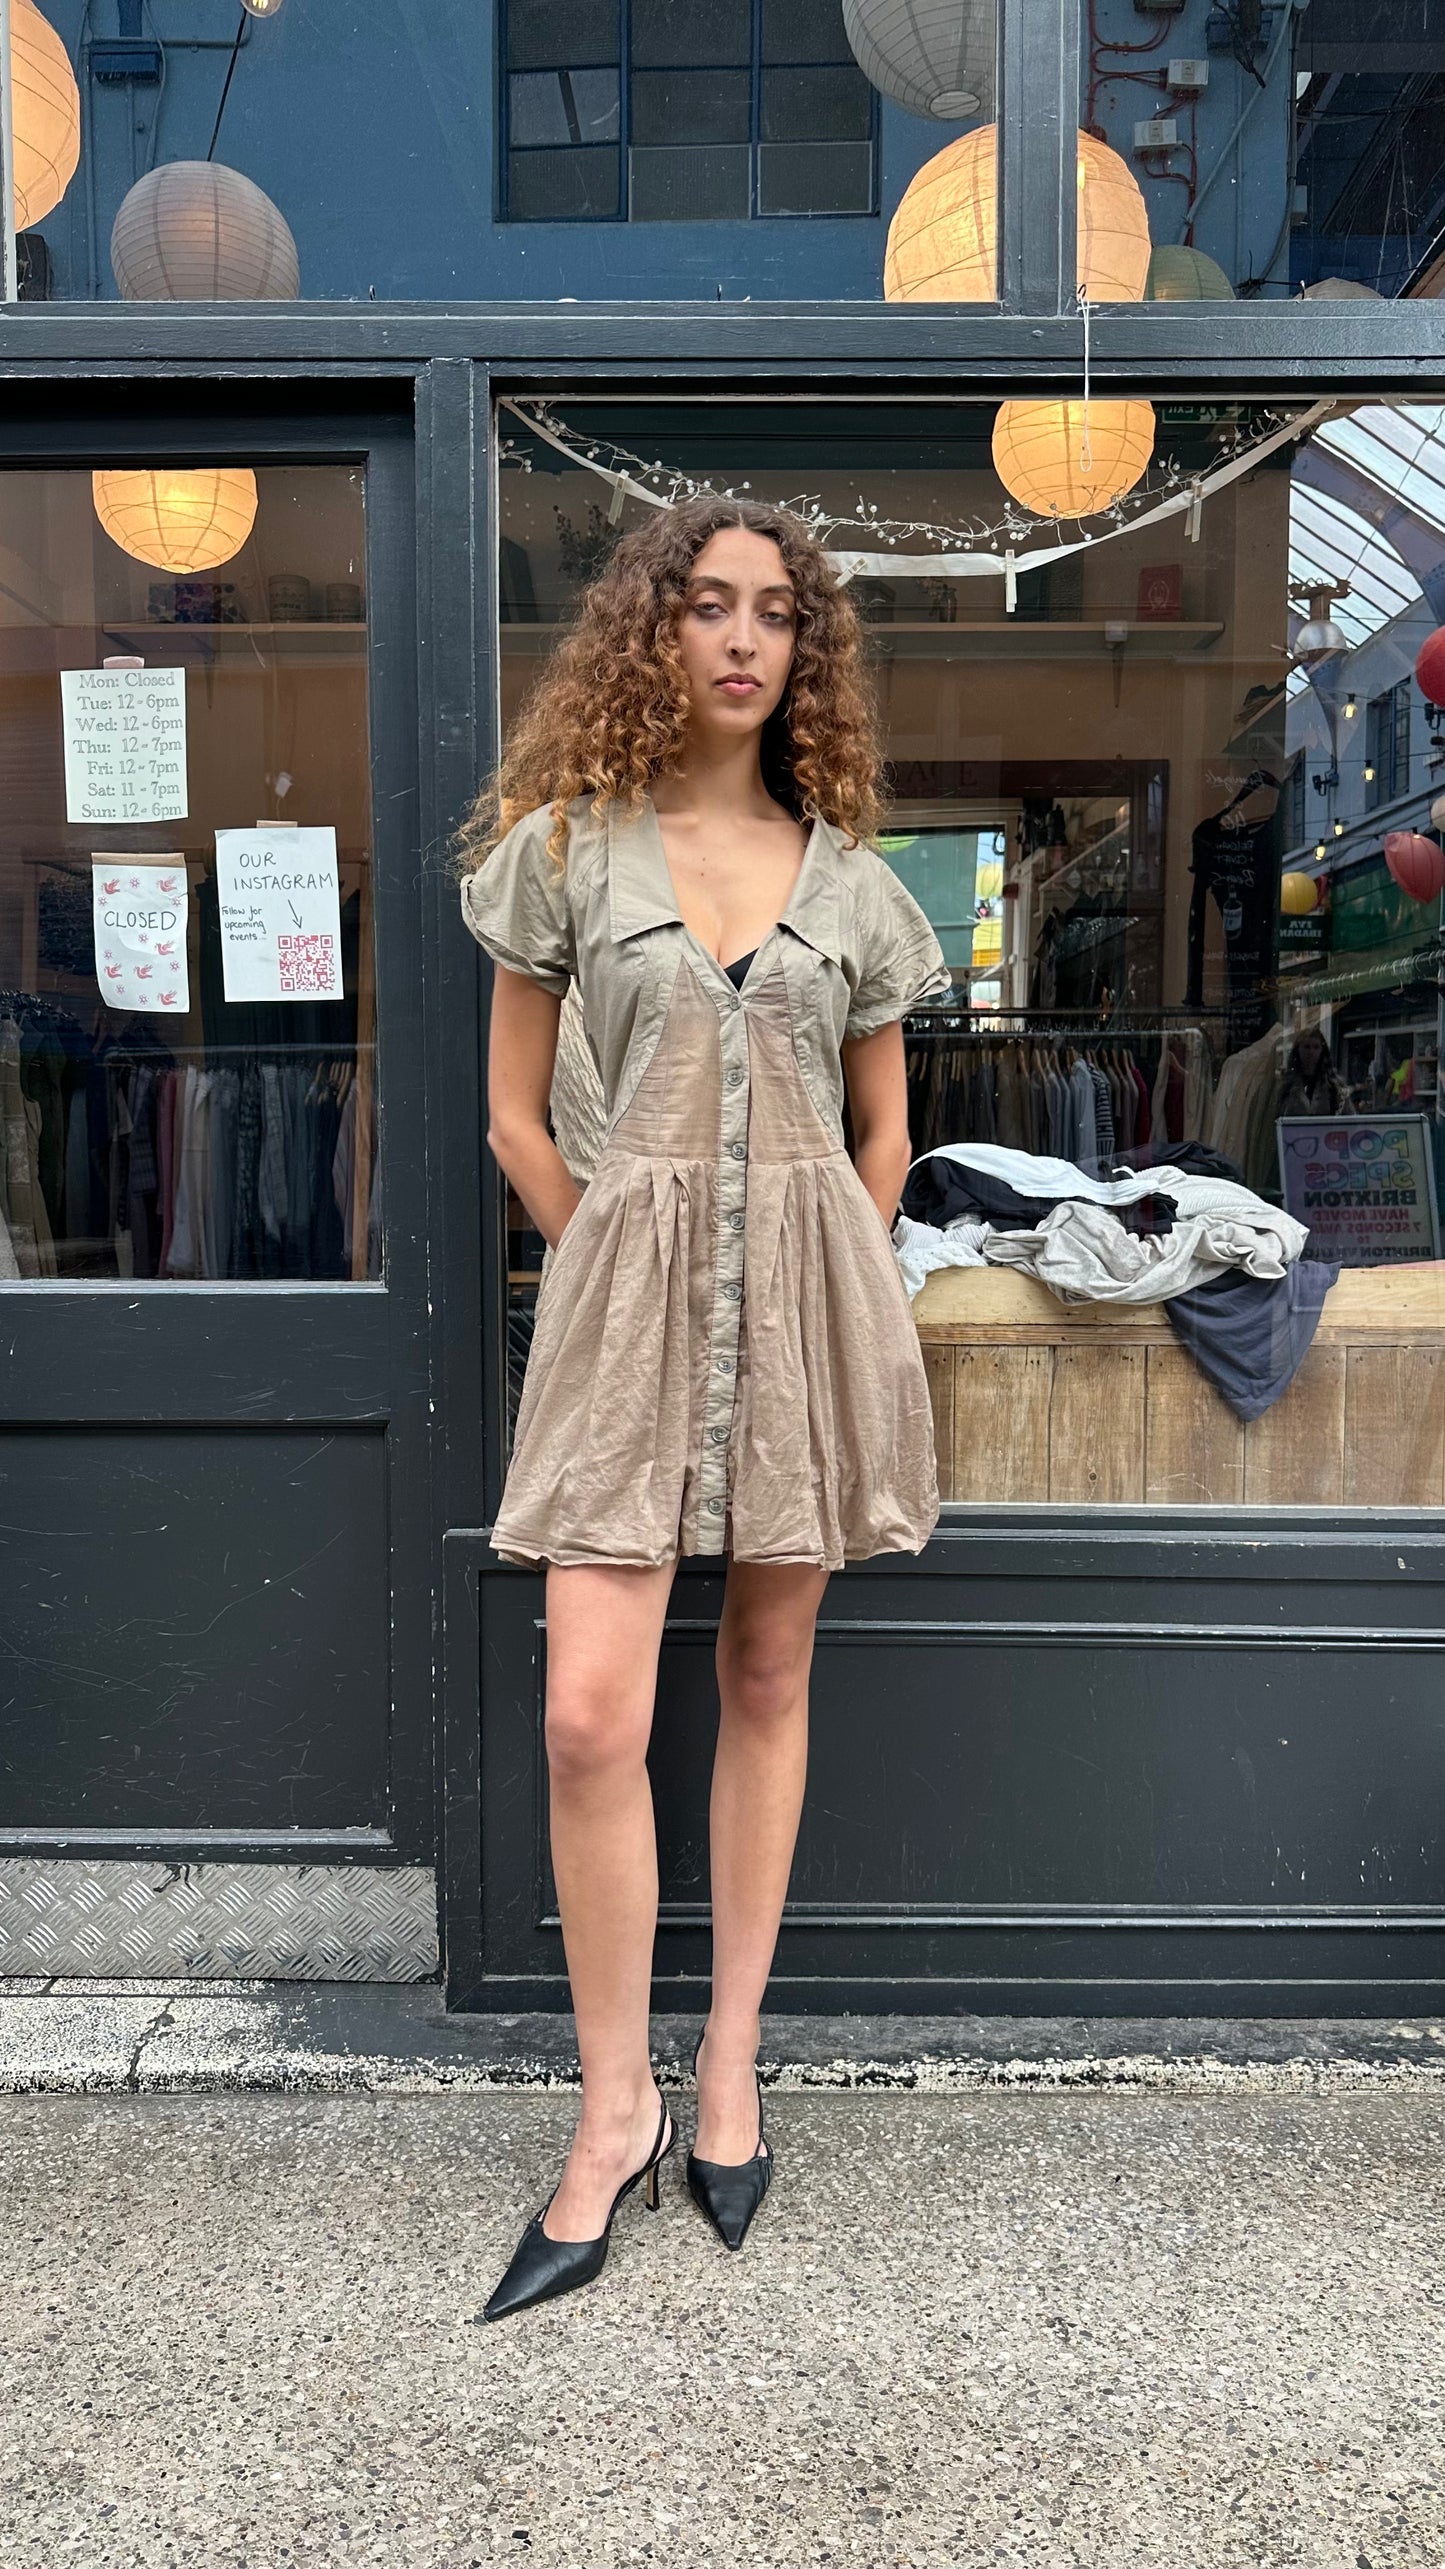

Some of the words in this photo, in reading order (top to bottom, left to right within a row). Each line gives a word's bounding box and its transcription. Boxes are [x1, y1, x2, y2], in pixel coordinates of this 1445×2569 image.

[78, 673, 119, 689] Mon:
[124, 671, 175, 687] Closed
[77, 695, 112, 710] Tue:
[75, 717, 118, 732] Wed:
[73, 739, 111, 754] Thu:
[86, 760, 114, 775] Fri:
[87, 782, 116, 797] Sat:
[81, 803, 116, 818] Sun:
[239, 851, 277, 868] OUR
[233, 872, 334, 891] INSTAGRAM
[103, 910, 177, 930] CLOSED
[221, 905, 246, 916] Follow
[248, 905, 263, 922] for
[224, 920, 267, 935] upcoming
